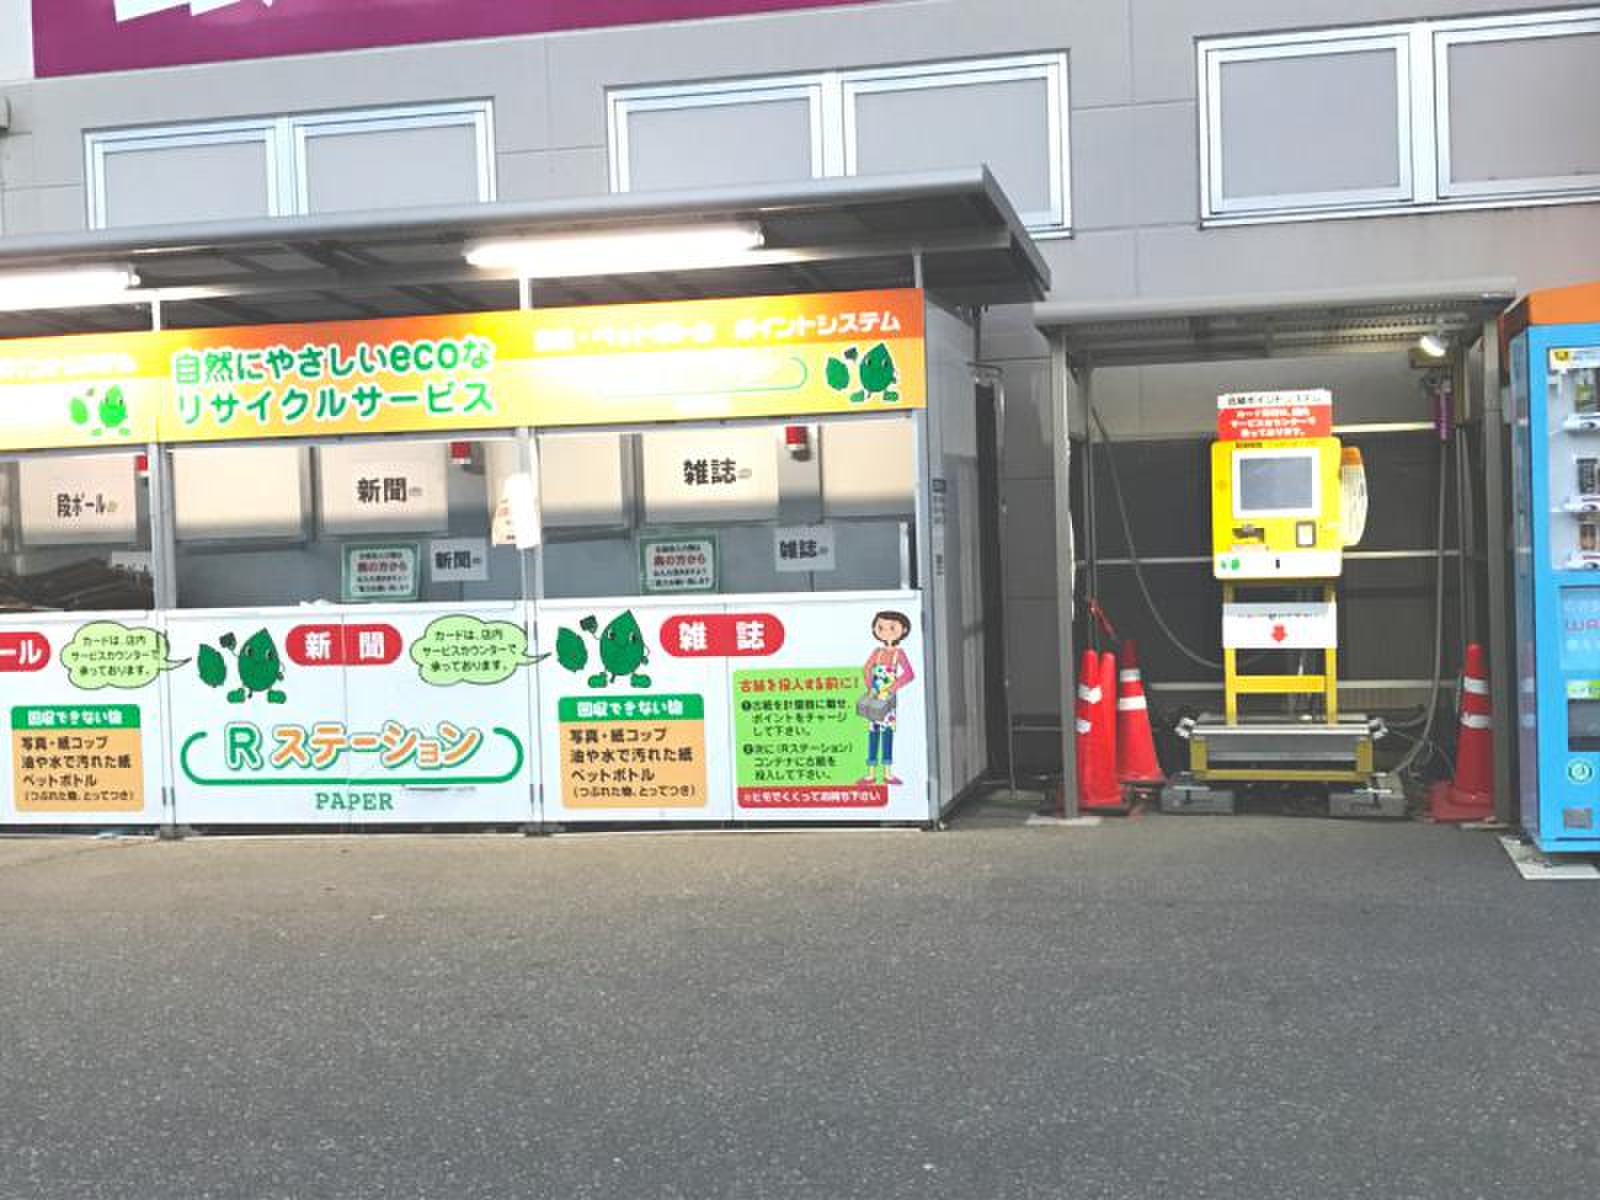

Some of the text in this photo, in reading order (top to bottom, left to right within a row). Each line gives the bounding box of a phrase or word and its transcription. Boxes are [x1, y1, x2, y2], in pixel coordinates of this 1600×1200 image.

[735, 311, 901, 338] ポイントシステム
[174, 340, 490, 384] 自然にやさしいecoな
[179, 381, 493, 425] リサイクルサービス
[684, 458, 737, 485] 雑誌
[357, 477, 407, 503] 新聞
[57, 493, 105, 518] 段ボール
[435, 551, 471, 569] 新聞
[780, 540, 817, 560] 雑誌
[305, 631, 385, 660] 新聞
[679, 621, 765, 651] 雑誌
[28, 710, 122, 725] 回収できない物
[577, 700, 684, 717] 回収できない物
[21, 736, 108, 750] 写真・紙コップ
[570, 728, 667, 744] 写真・紙コップ
[21, 754, 131, 769] 油や水で汚れた紙
[570, 747, 693, 763] 油や水で汚れた紙
[571, 768, 655, 782] ペットボトル
[315, 791, 394, 812] PAPER
